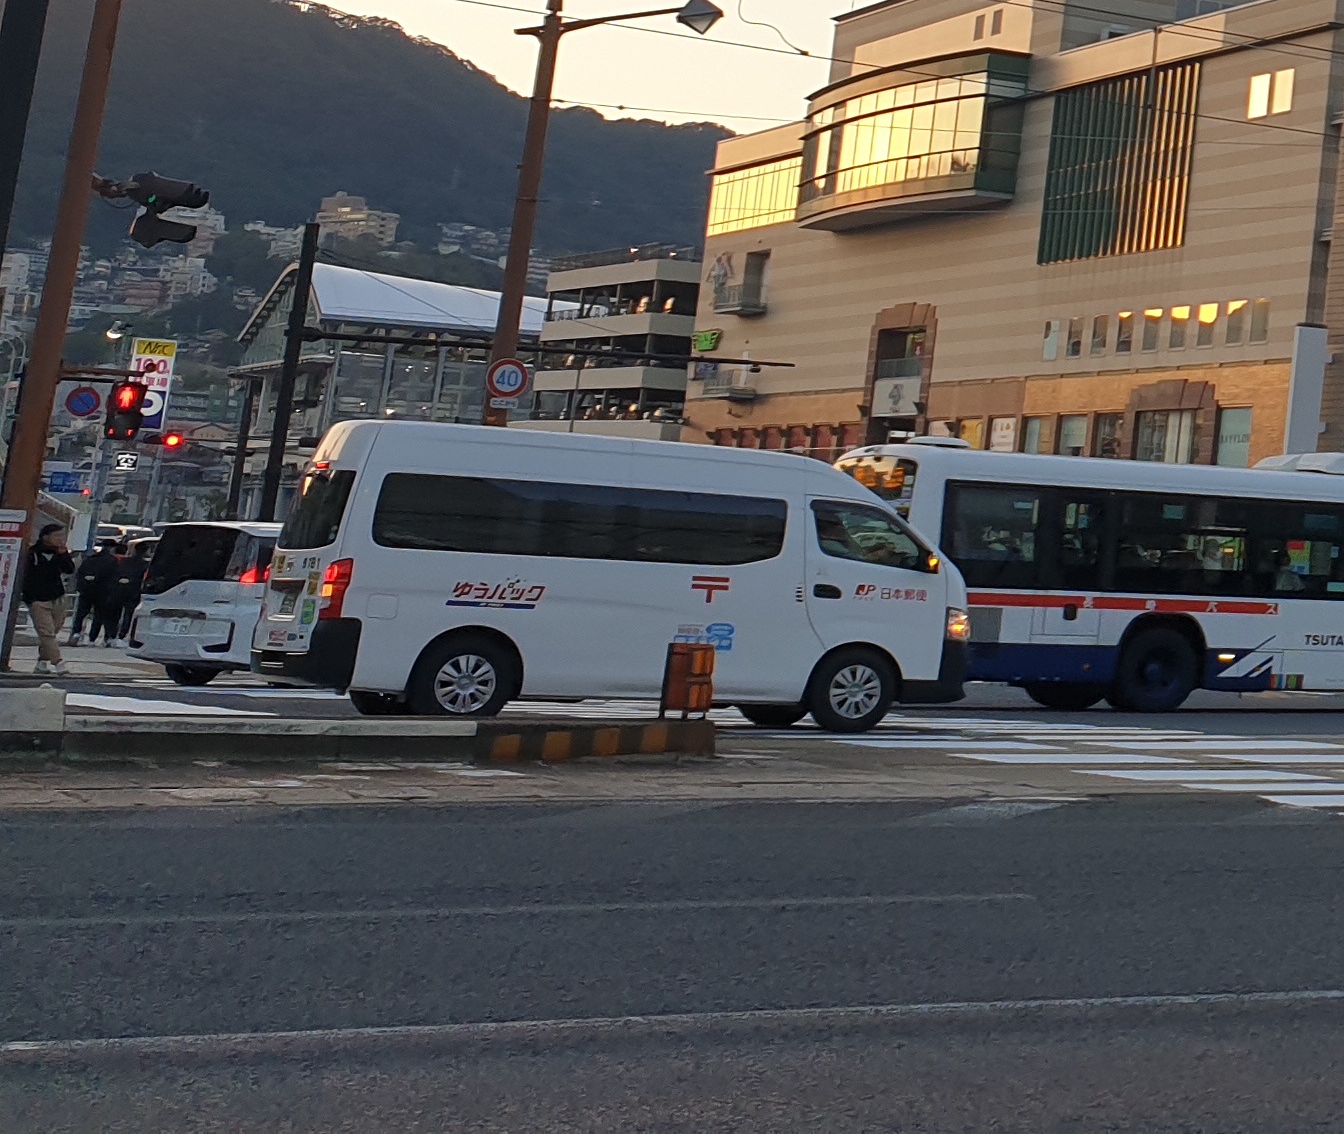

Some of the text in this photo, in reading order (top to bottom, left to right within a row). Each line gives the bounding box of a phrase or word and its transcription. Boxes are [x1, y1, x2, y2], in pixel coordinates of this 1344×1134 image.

[496, 369, 519, 387] 40
[116, 454, 137, 470] 空
[452, 577, 545, 601] ゆうパック
[855, 584, 876, 596] JP
[880, 587, 927, 601] 日本郵便
